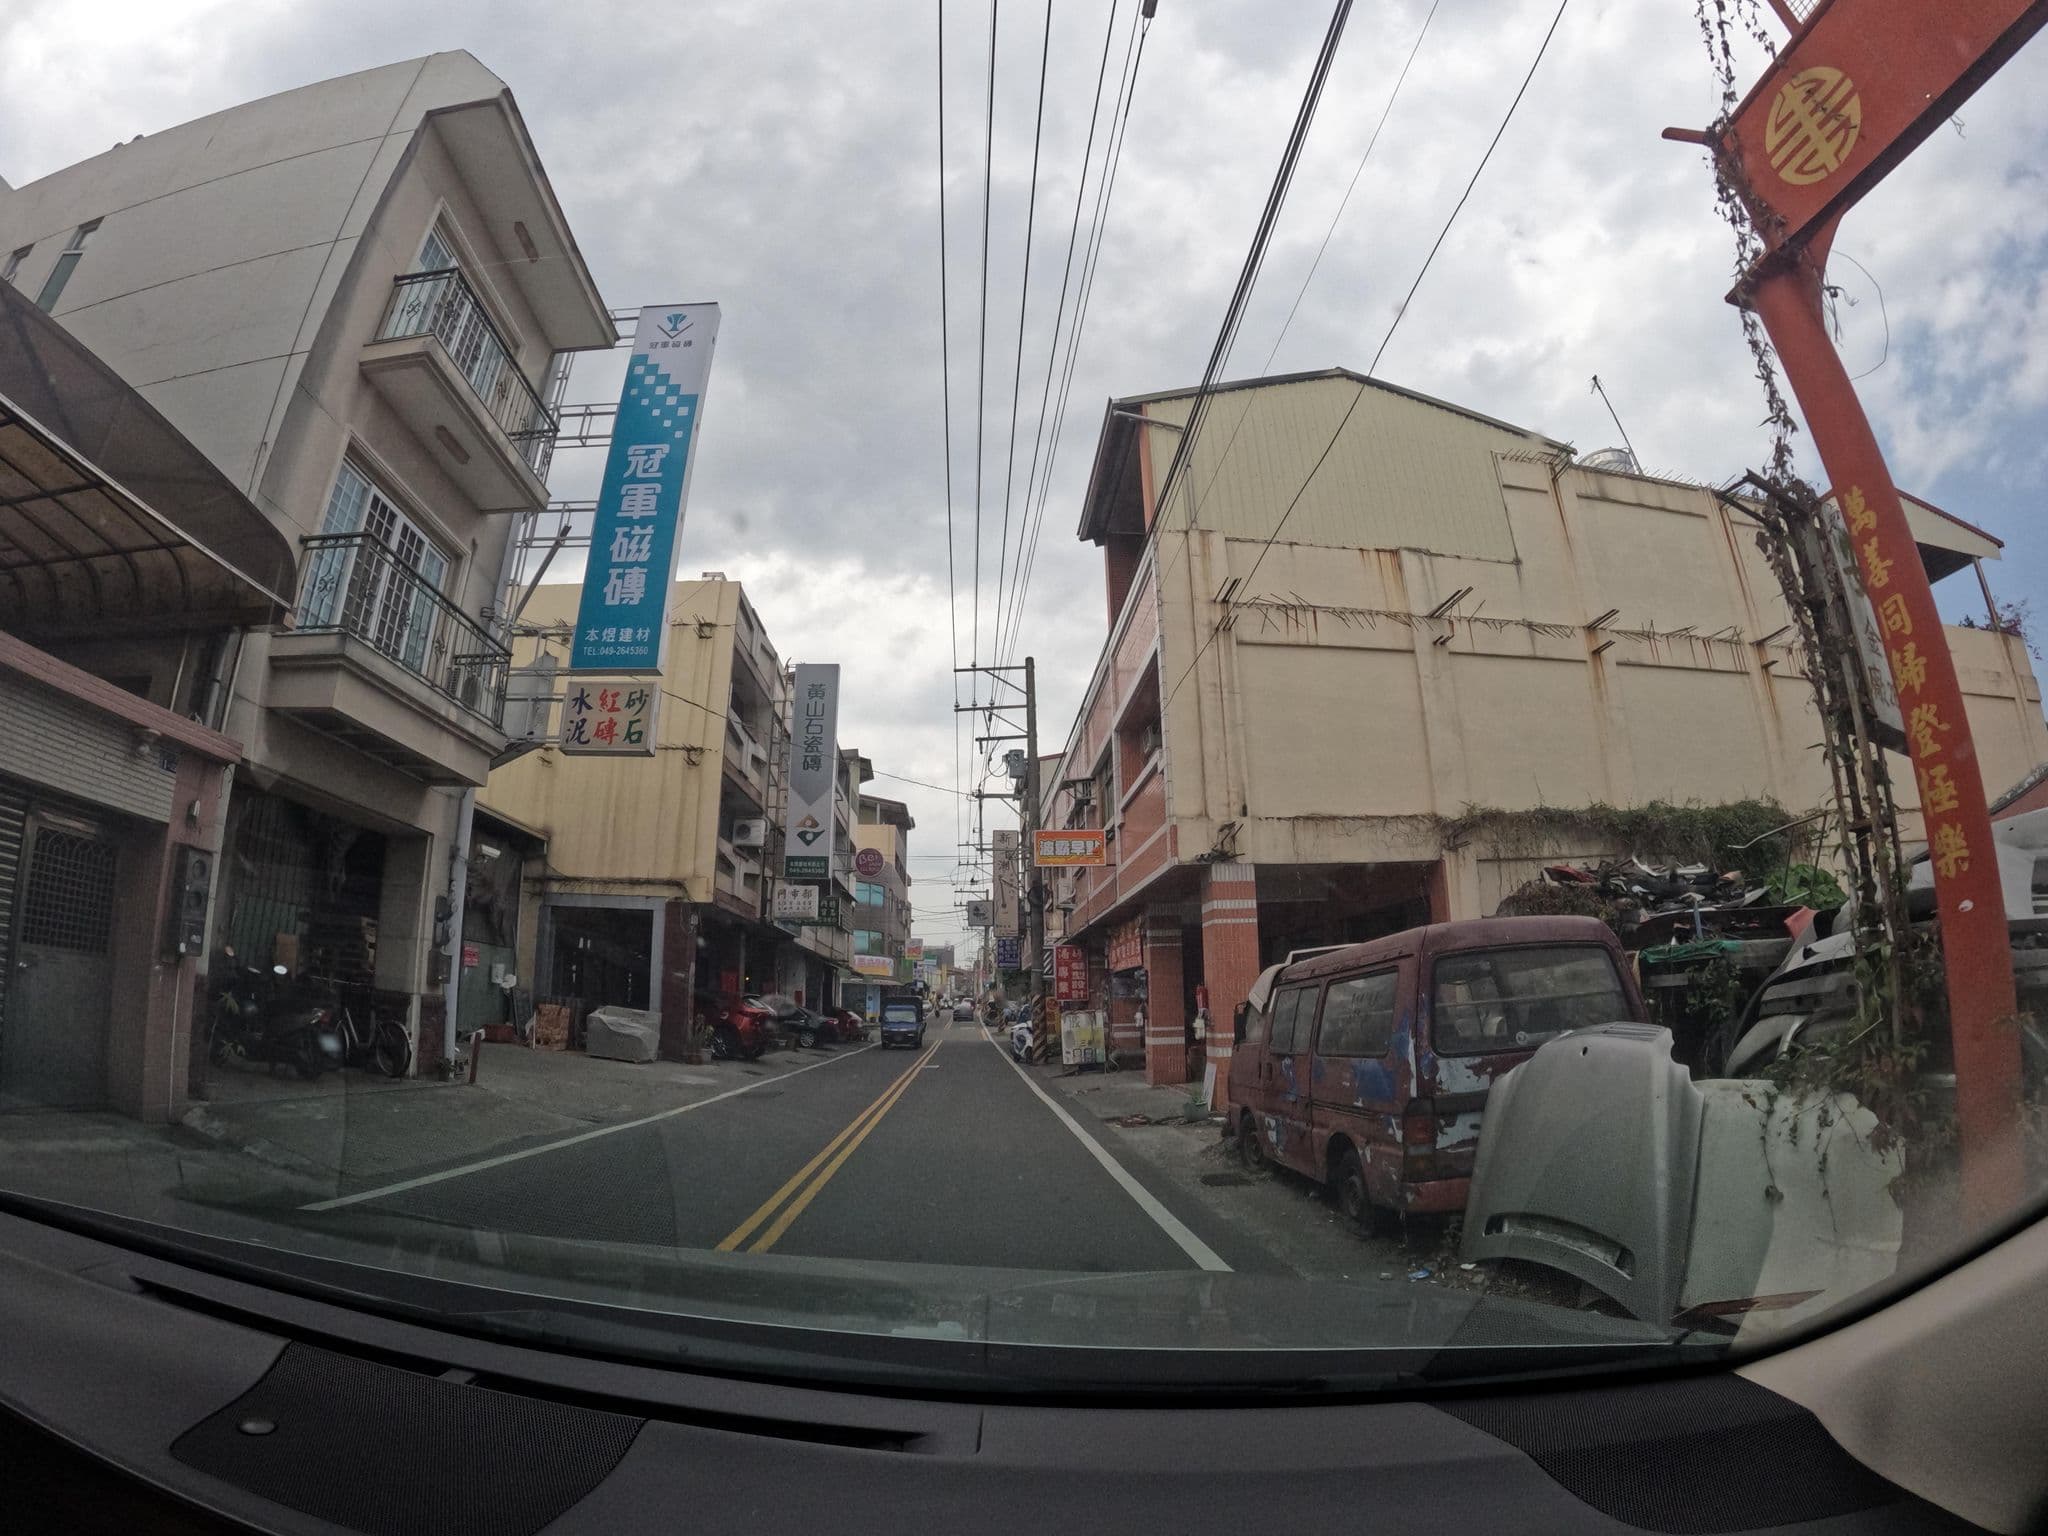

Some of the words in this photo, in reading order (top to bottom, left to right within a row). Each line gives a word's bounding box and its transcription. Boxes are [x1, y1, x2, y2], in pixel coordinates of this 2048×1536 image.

[603, 444, 670, 606] 冠軍磁磚
[584, 627, 650, 642] 本煜建材
[565, 687, 593, 745] 水泥
[593, 688, 621, 746] 紅磚
[622, 688, 650, 745] 砂石
[802, 683, 826, 772] 黃山石瓷磚
